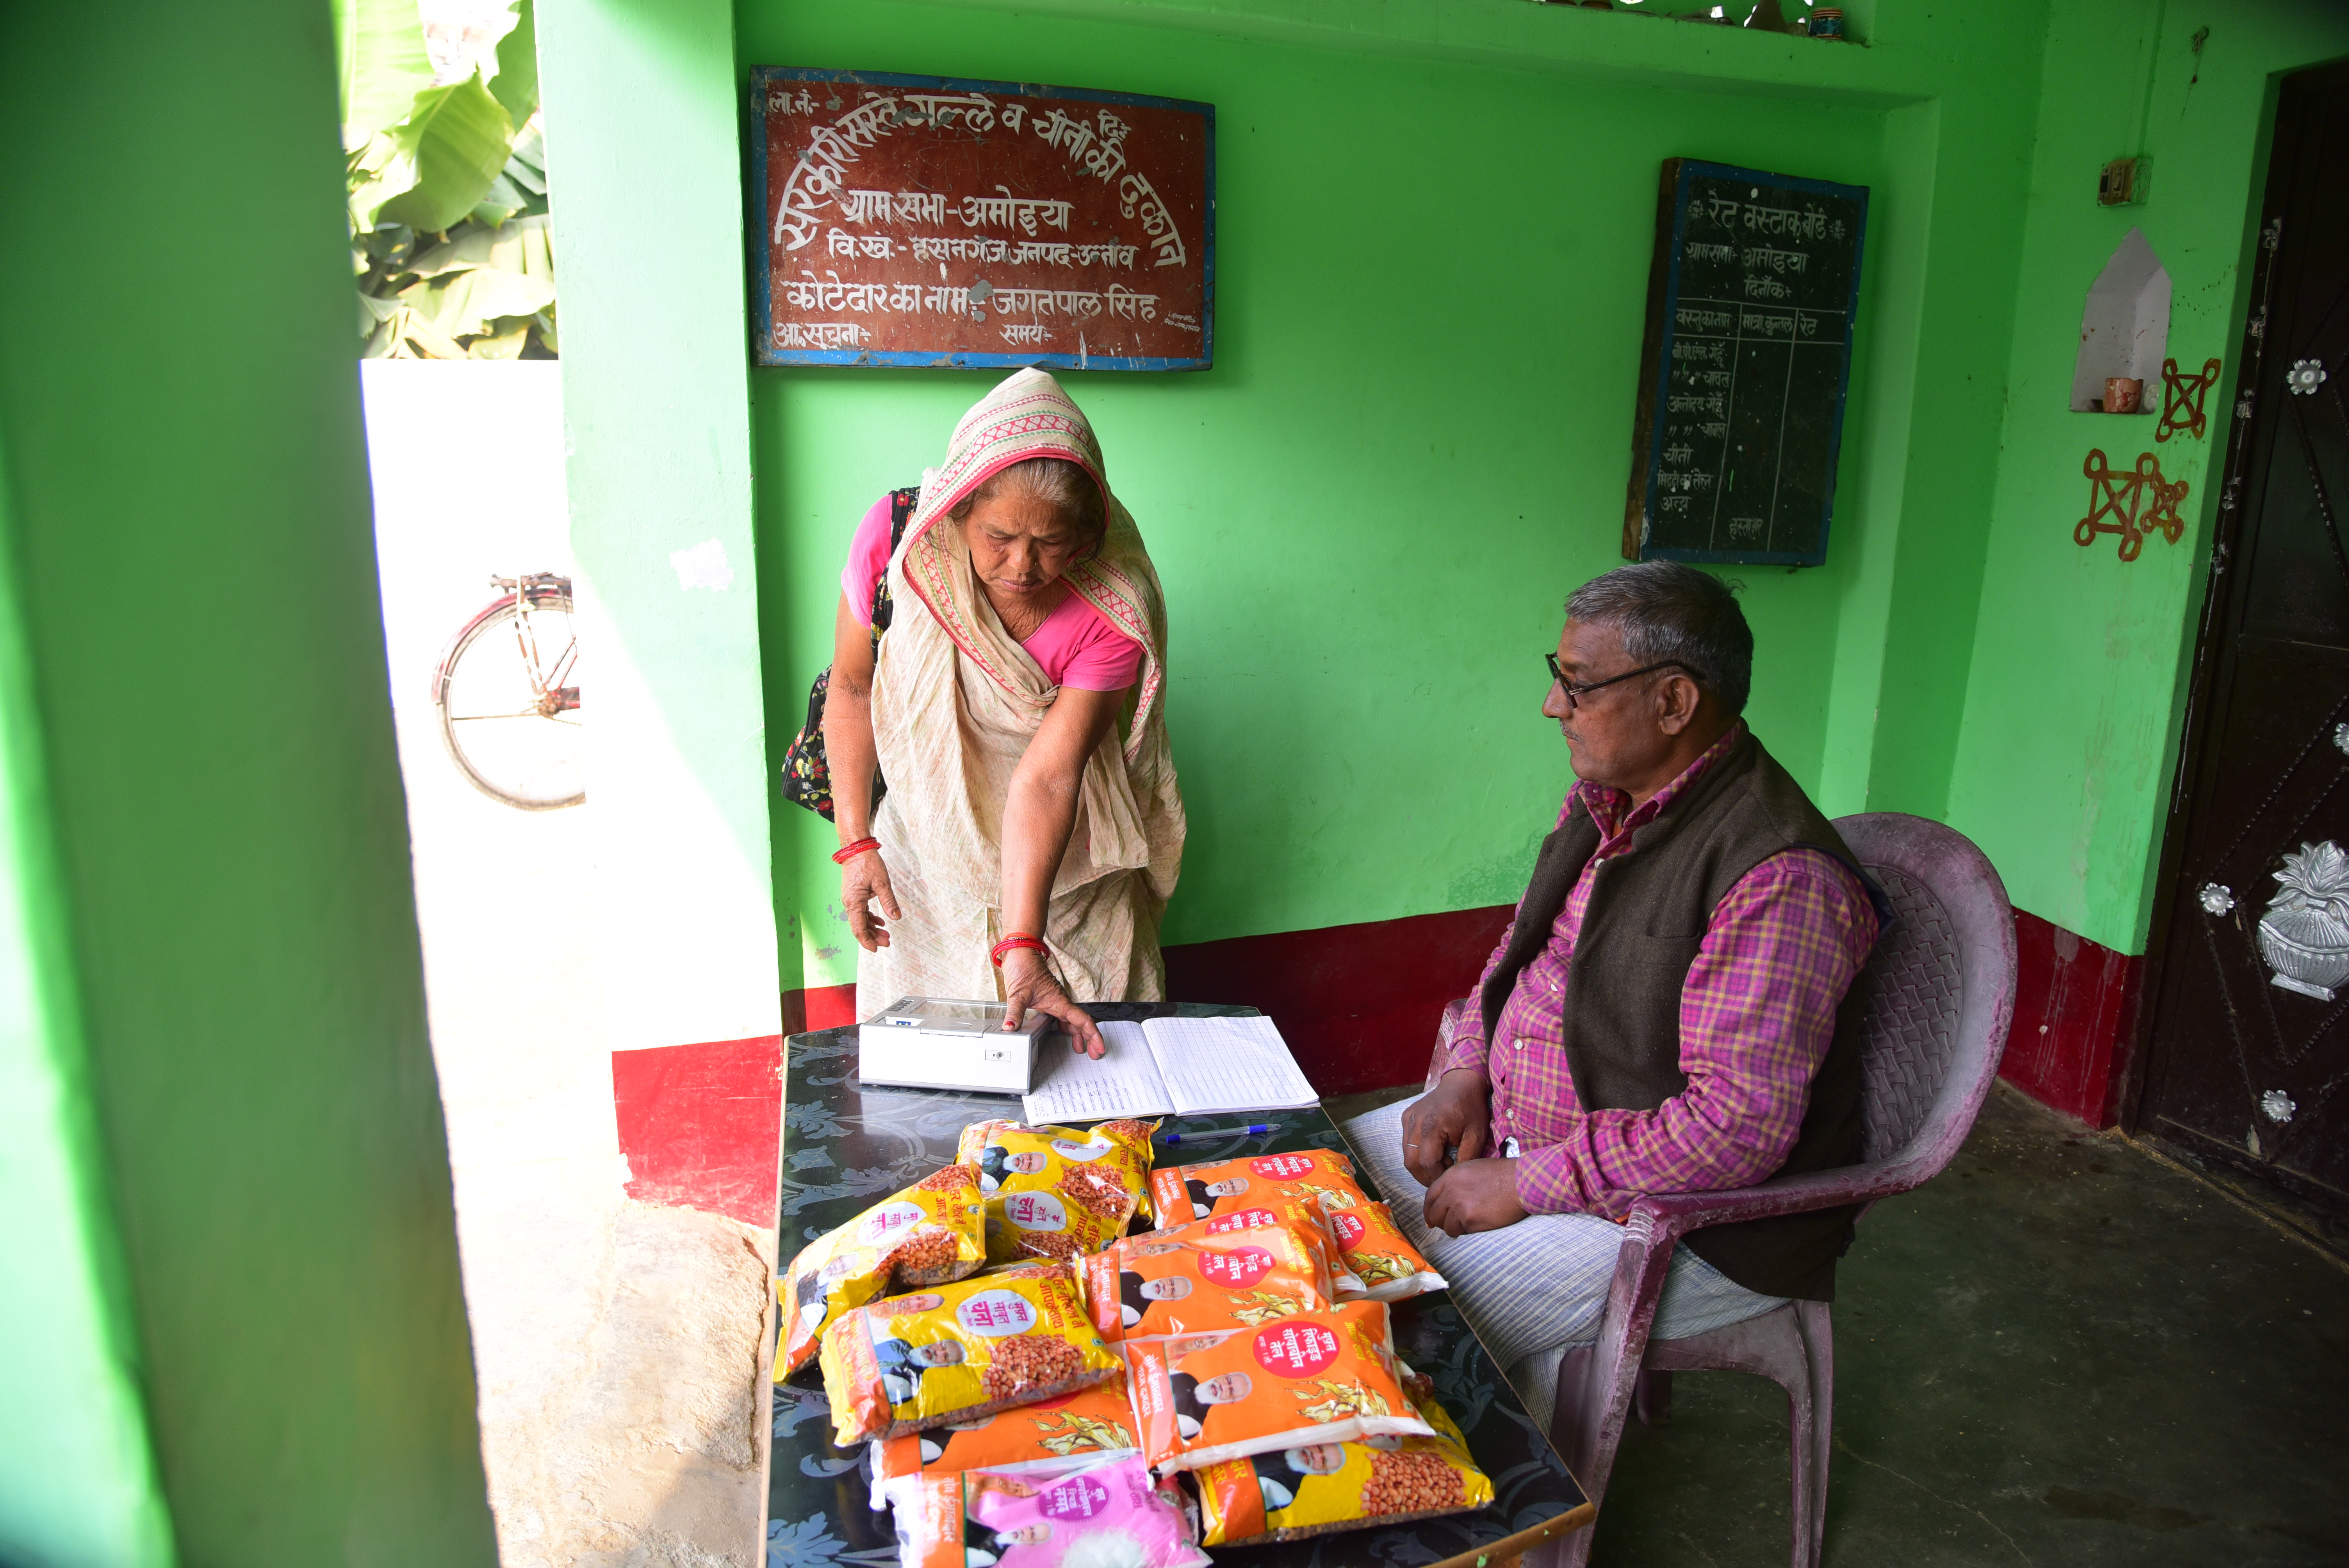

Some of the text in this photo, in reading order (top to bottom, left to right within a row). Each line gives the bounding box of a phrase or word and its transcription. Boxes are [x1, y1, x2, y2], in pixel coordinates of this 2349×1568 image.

[774, 125, 860, 251] सरकारी
[835, 91, 898, 147] सस्ते
[1002, 103, 1028, 135] व
[1032, 108, 1098, 163] चीनी
[1085, 137, 1126, 185] की
[1119, 171, 1187, 267] दुकान
[840, 190, 894, 225] ग्राम
[1708, 190, 1740, 228] रेट
[780, 269, 890, 313] कोटेदार
[889, 282, 923, 314] का
[992, 288, 1104, 317] जगतपाल
[1103, 283, 1161, 323] सिंह
[1799, 312, 1818, 337] रेट
[1702, 371, 1732, 388] चावल
[1663, 442, 1695, 466] चीनी
[1693, 467, 1715, 490] तेल
[1660, 495, 1693, 511] अन्य
[1262, 1162, 1273, 1171] तेल
[1271, 1157, 1289, 1176] सोयाबीन
[949, 1188, 961, 1201] हर
[1156, 1176, 1171, 1206] काम दमदार
[1164, 1171, 1181, 1200] सोच ईमानदार
[1016, 1196, 1035, 1223] चना
[1362, 1205, 1388, 1235] आपके साथ
[1280, 1234, 1295, 1260] आपके
[1292, 1238, 1310, 1269] मुश्किल
[1039, 1283, 1059, 1310] आपके
[1100, 1267, 1114, 1302] ईमानदार
[971, 1301, 995, 1327] चना
[992, 1301, 1011, 1324] साबुत
[1071, 1320, 1087, 1329] में
[1269, 1340, 1285, 1358] तेल
[1282, 1327, 1306, 1368] सोयाबीन
[1301, 1328, 1325, 1361] रिफाइंड
[1352, 1343, 1366, 1360] साथ
[1263, 1356, 1273, 1365] ली.
[1137, 1363, 1151, 1417] काम दमदार
[1145, 1352, 1164, 1413] सोच ईमानदार
[942, 1476, 961, 1542] सोच ईमानदार
